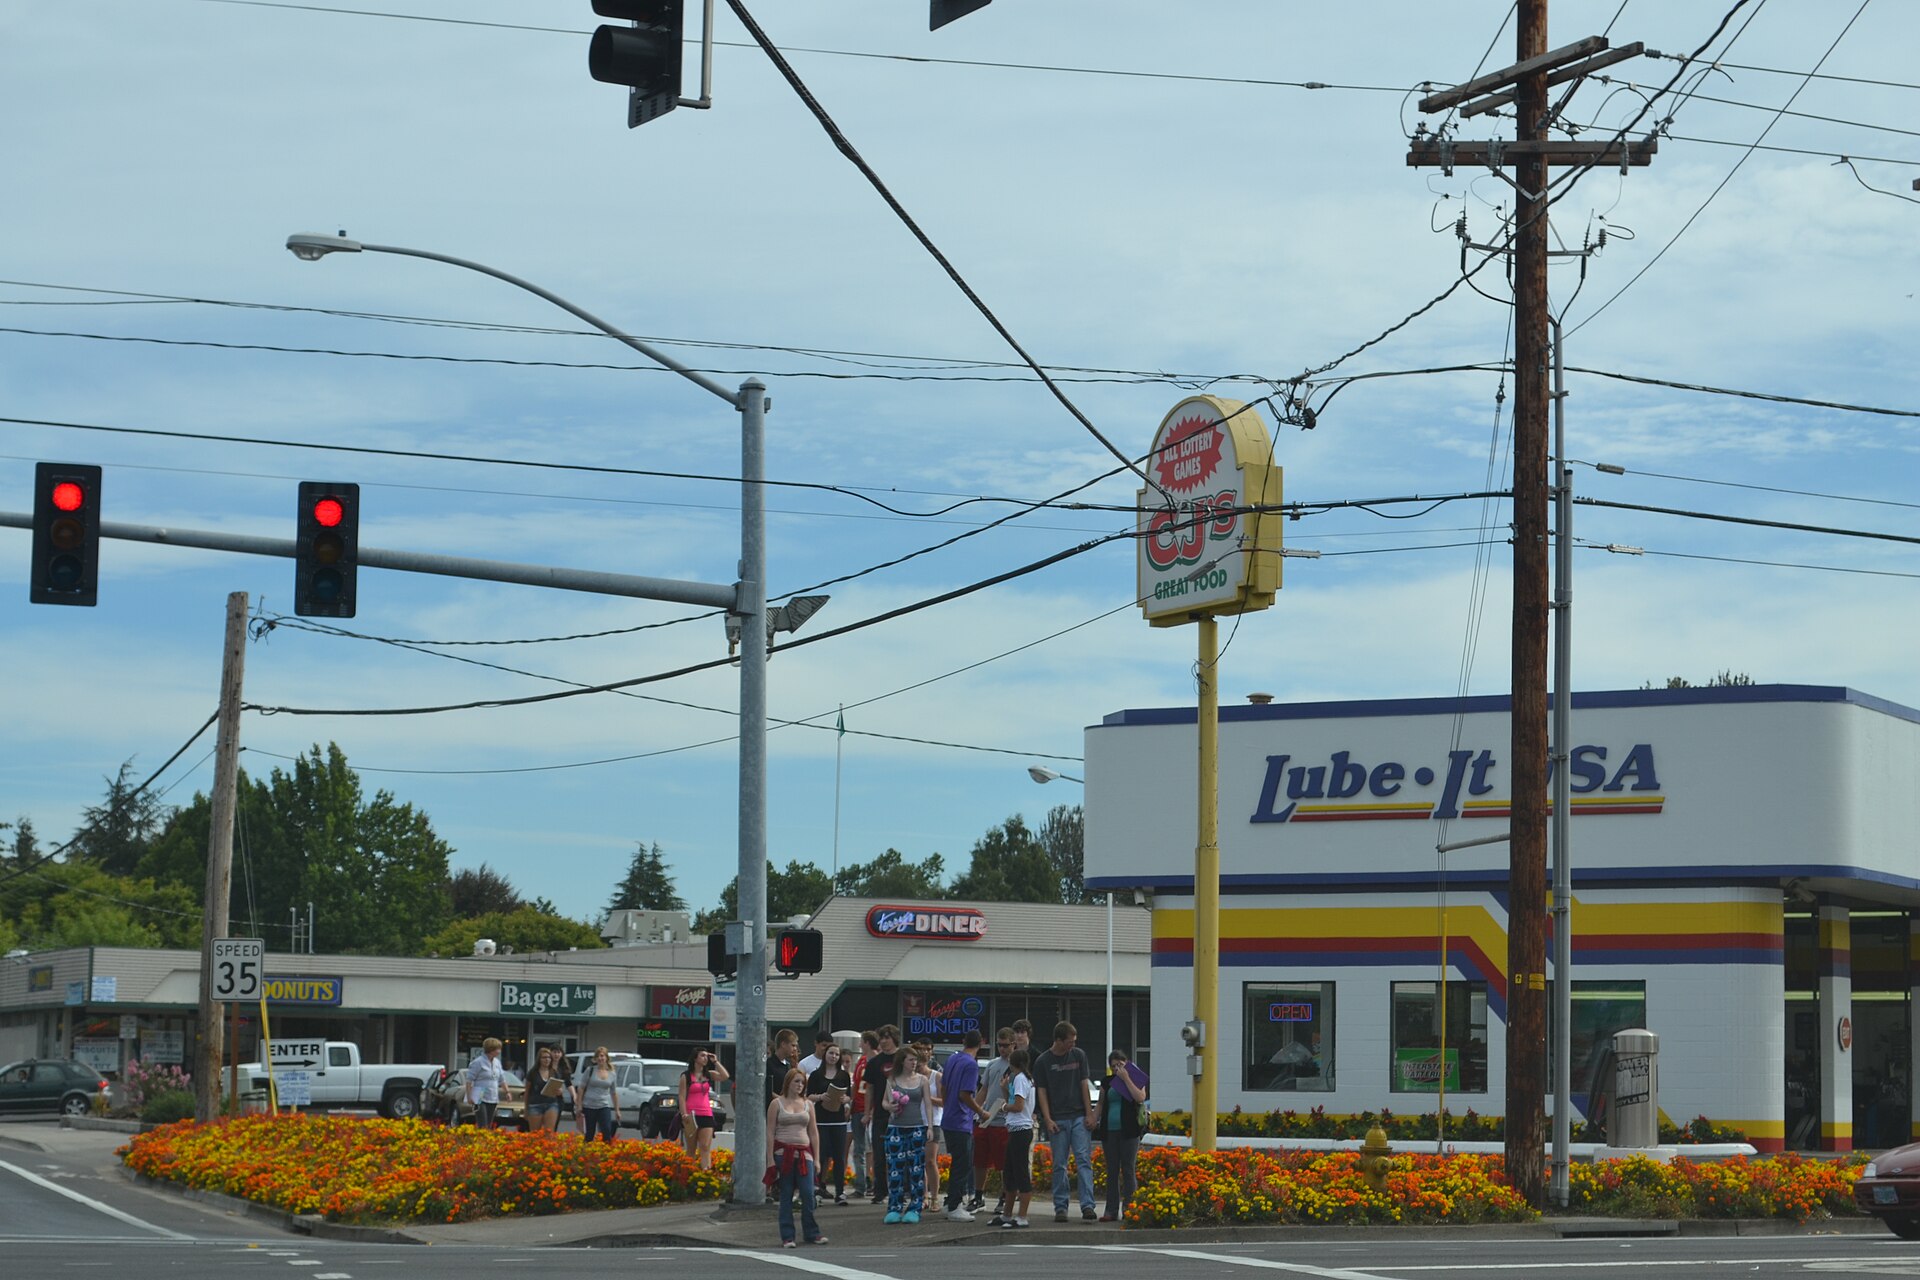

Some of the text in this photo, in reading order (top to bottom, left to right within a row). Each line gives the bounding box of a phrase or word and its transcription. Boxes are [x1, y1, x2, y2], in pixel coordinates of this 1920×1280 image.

[1163, 430, 1214, 463] ALL LOTTERY
[1174, 456, 1201, 481] GAMES
[1155, 569, 1228, 600] GREAT FOOD
[1250, 743, 1661, 823] Lube It SA
[915, 914, 988, 935] DINER
[215, 944, 260, 957] SPEED
[217, 961, 257, 995] 35
[502, 985, 594, 1013] Bagel Ave
[1271, 1005, 1310, 1019] OPEN
[637, 1029, 669, 1038] DINER
[911, 1018, 981, 1034] DINER
[269, 1044, 320, 1056] ENTER
